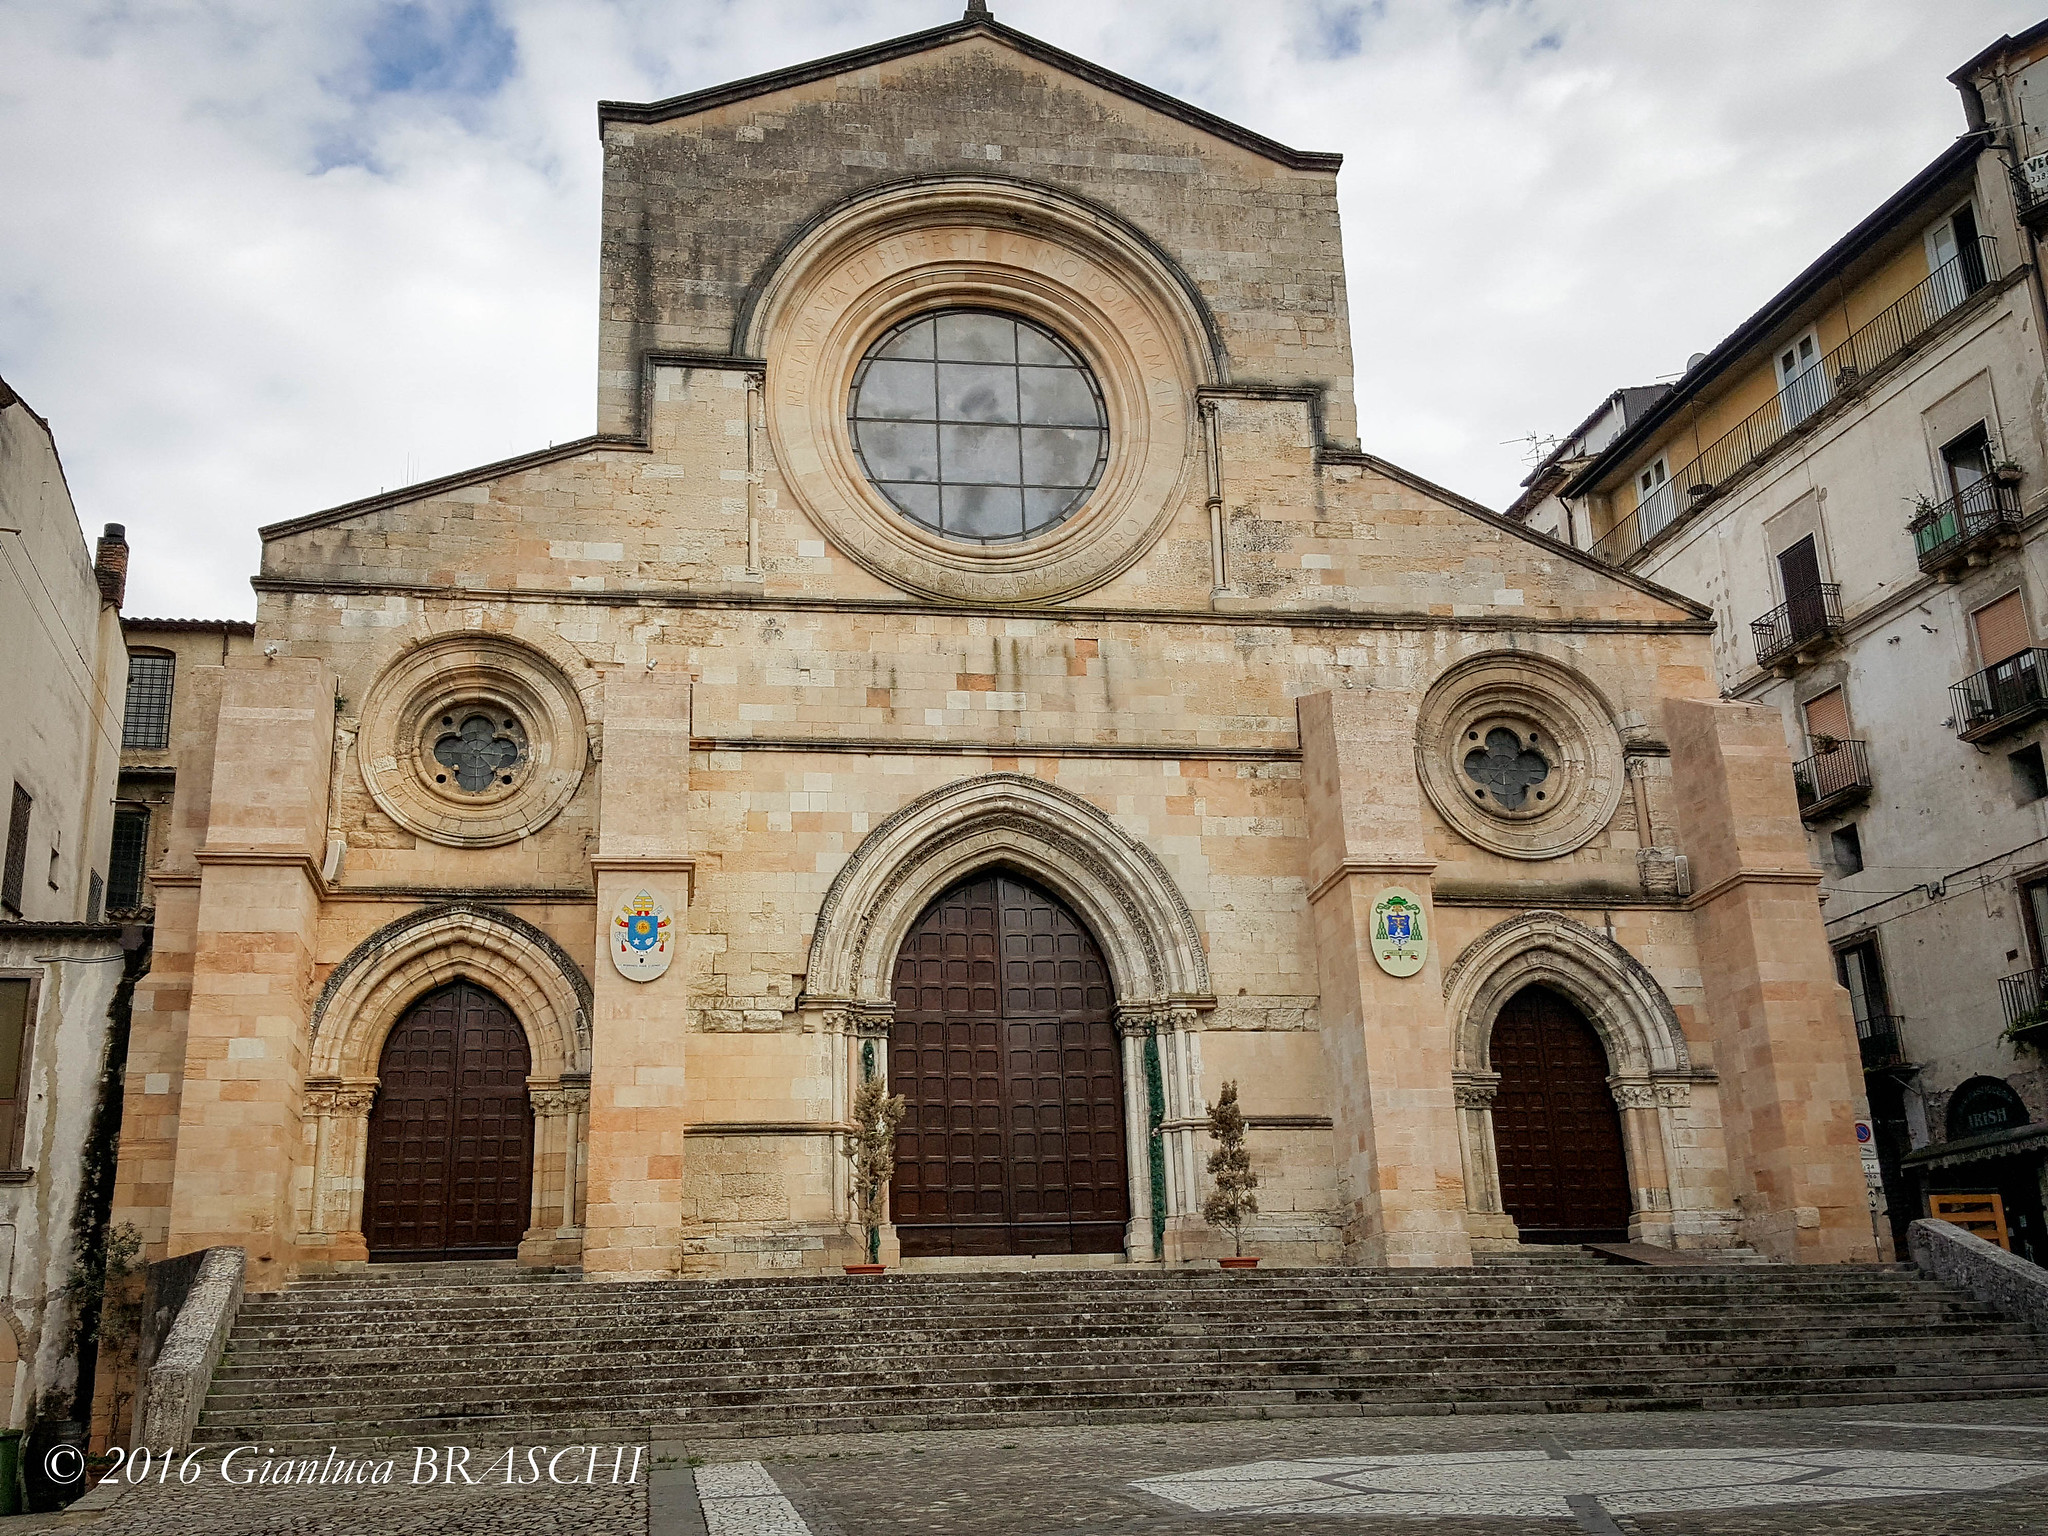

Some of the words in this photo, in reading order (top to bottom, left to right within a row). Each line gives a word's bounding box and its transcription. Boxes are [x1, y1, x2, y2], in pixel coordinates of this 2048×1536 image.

[2030, 170, 2048, 184] 338
[846, 258, 873, 286] ET
[875, 233, 989, 268] PERFECTA
[1007, 240, 1079, 277] ANNO
